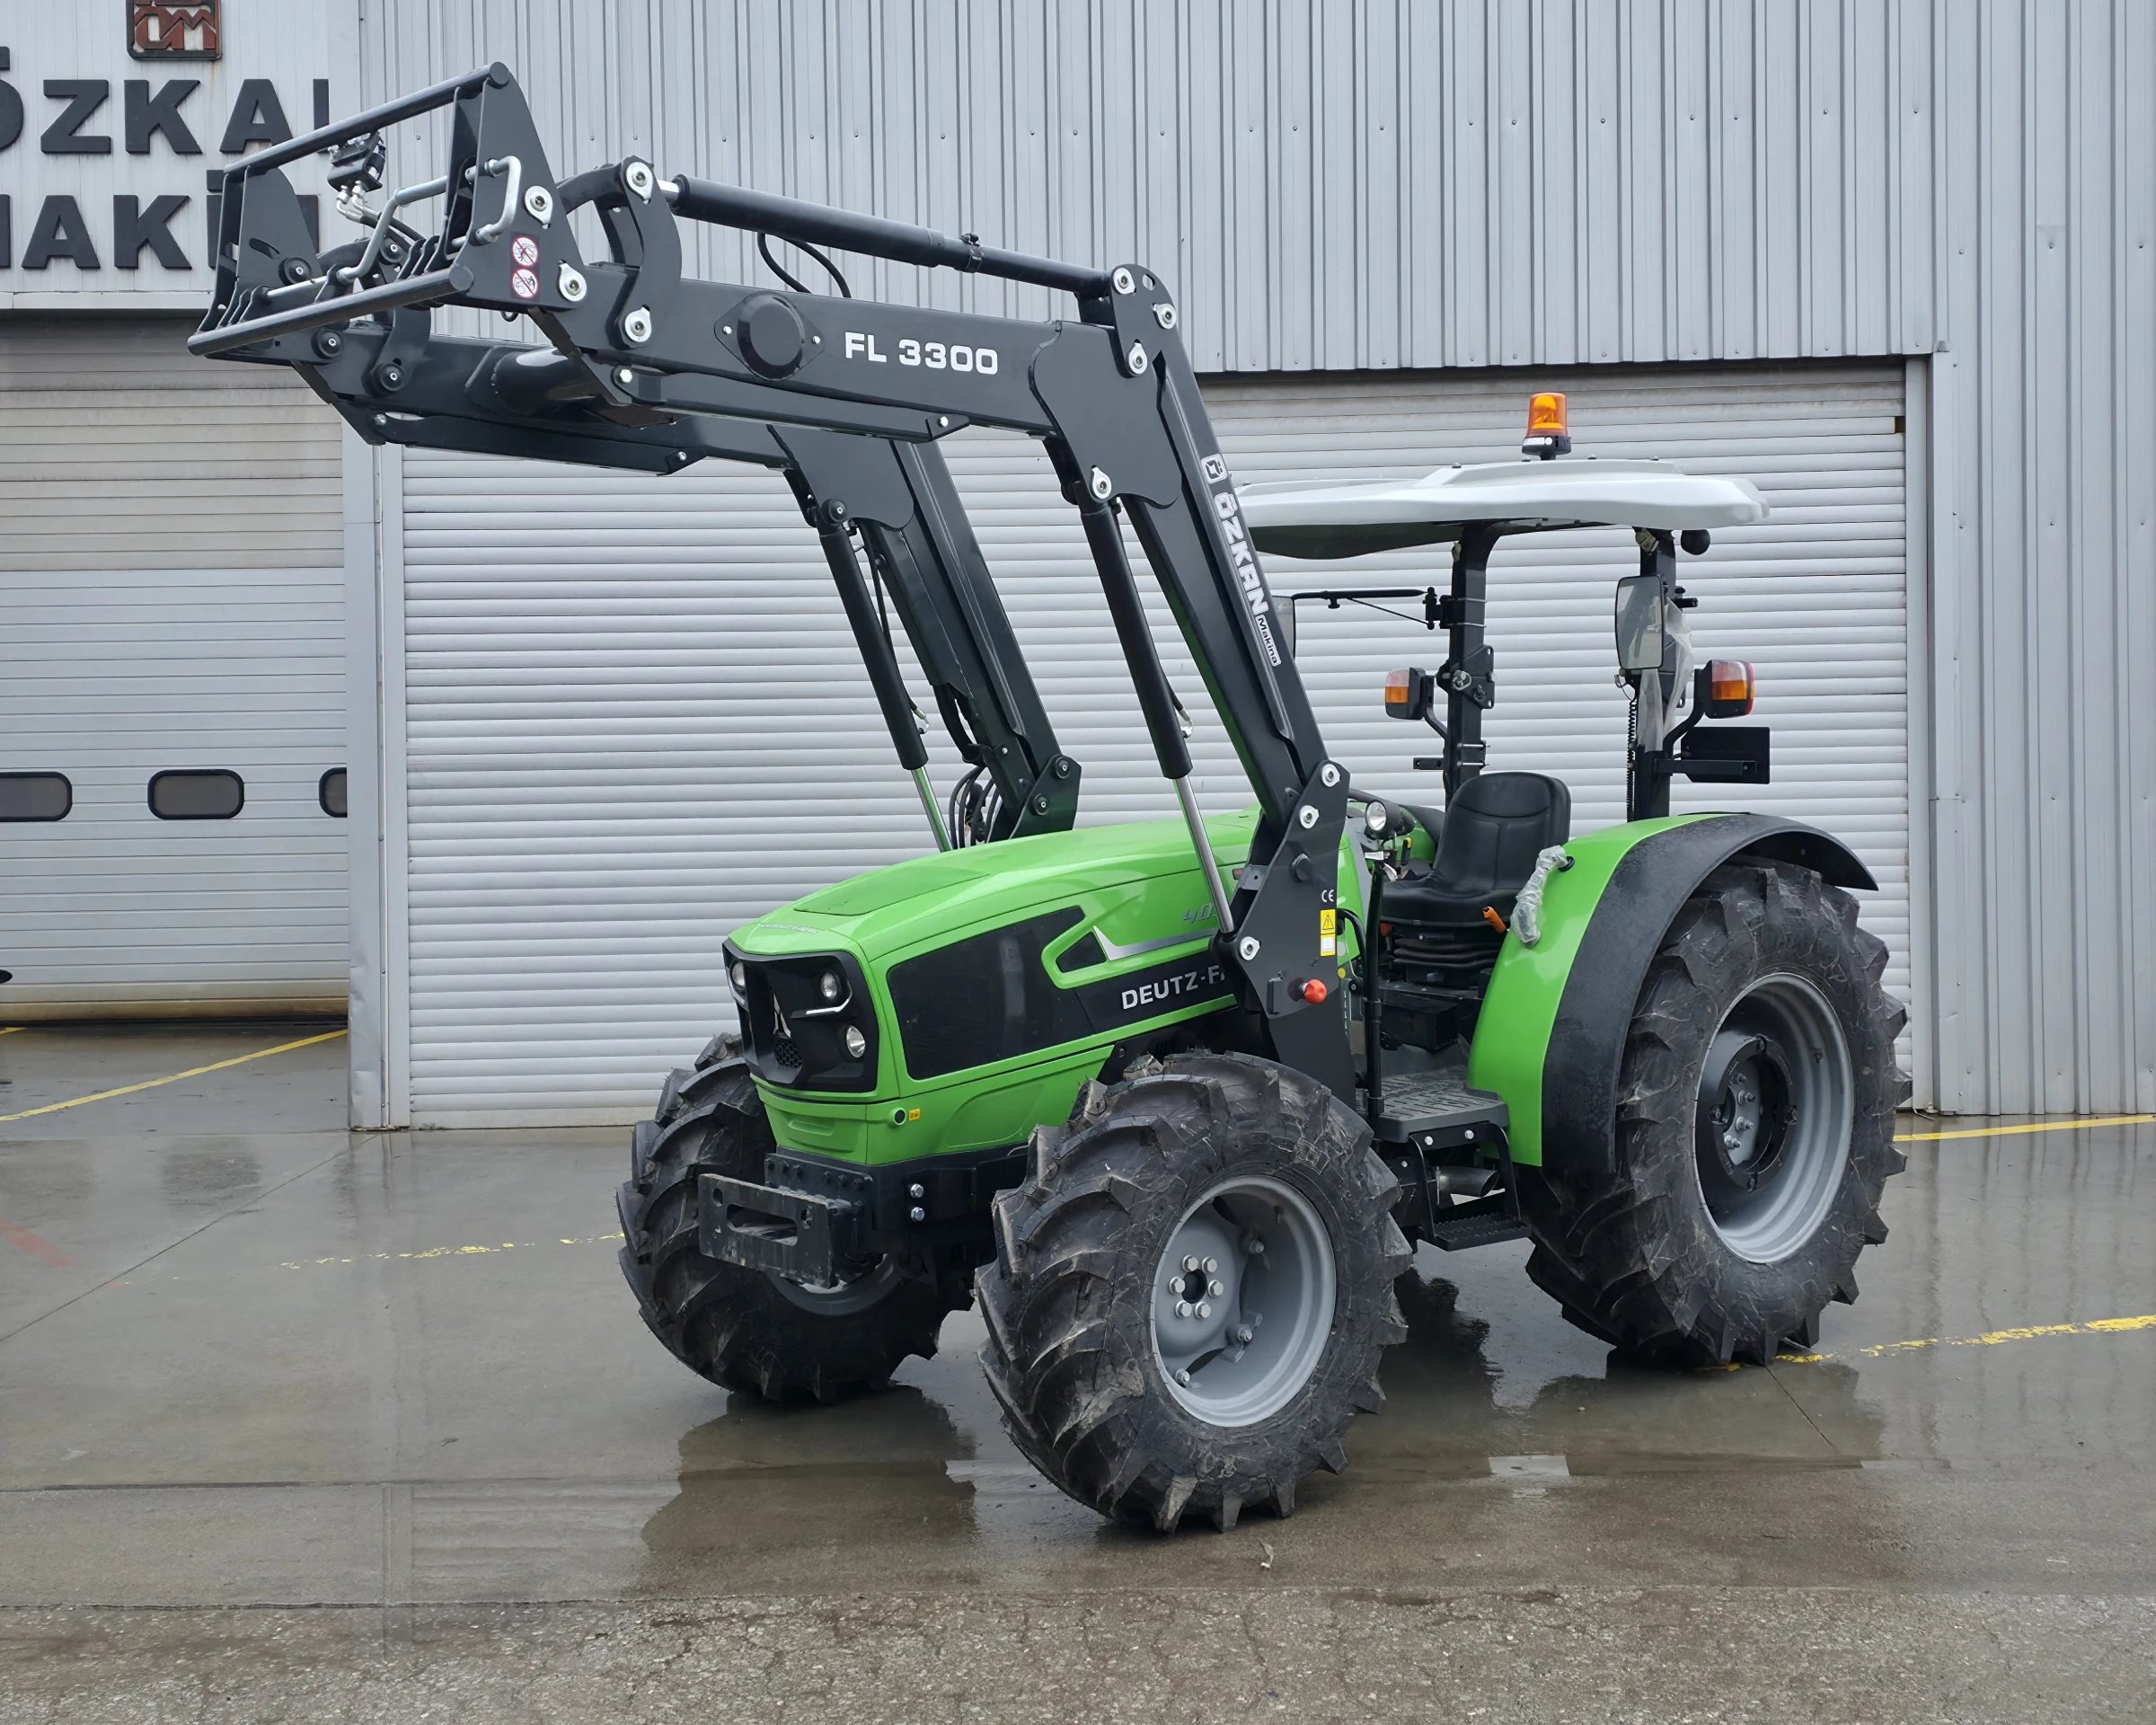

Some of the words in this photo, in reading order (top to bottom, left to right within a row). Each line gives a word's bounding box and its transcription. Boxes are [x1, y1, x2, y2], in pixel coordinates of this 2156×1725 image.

[844, 332, 888, 363] FL
[898, 339, 999, 376] 3300
[1214, 492, 1269, 615] ÖZKAN
[1258, 617, 1277, 665] Makina
[1321, 889, 1335, 903] CE
[1121, 964, 1225, 1010] DEUTZ-F
